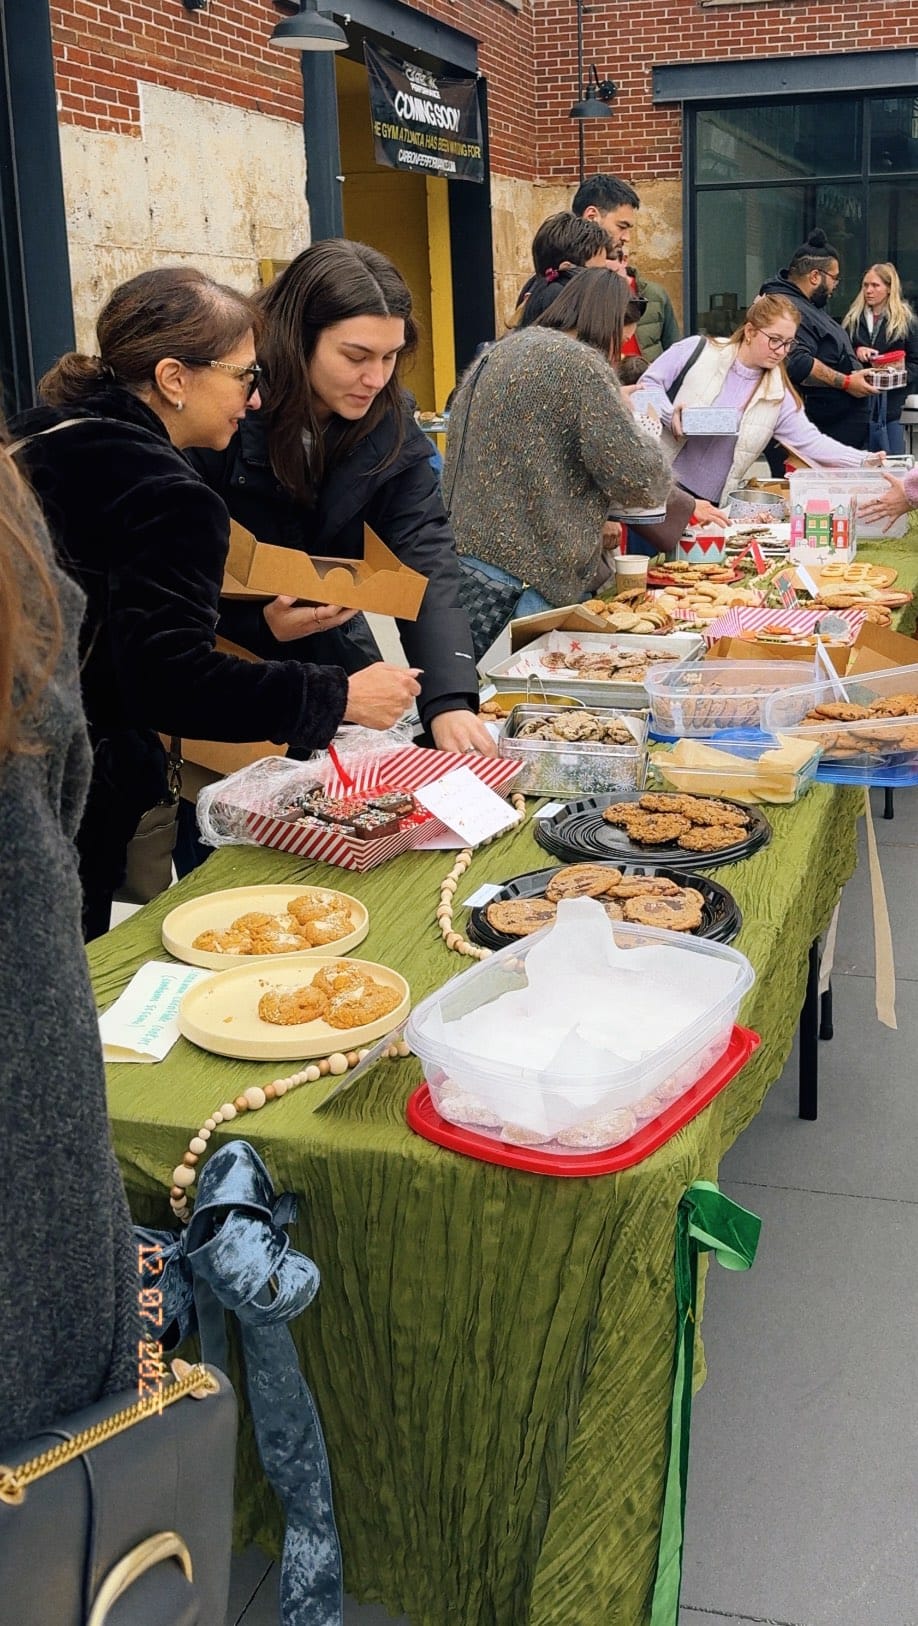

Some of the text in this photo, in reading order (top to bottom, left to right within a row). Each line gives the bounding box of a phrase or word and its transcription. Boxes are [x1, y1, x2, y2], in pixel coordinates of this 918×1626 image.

[394, 90, 461, 133] COMING SOON
[382, 123, 399, 140] GYM
[399, 127, 425, 147] ATLANTA
[425, 133, 438, 150] HAS
[437, 137, 450, 153] BEEN
[467, 143, 481, 159] FOR
